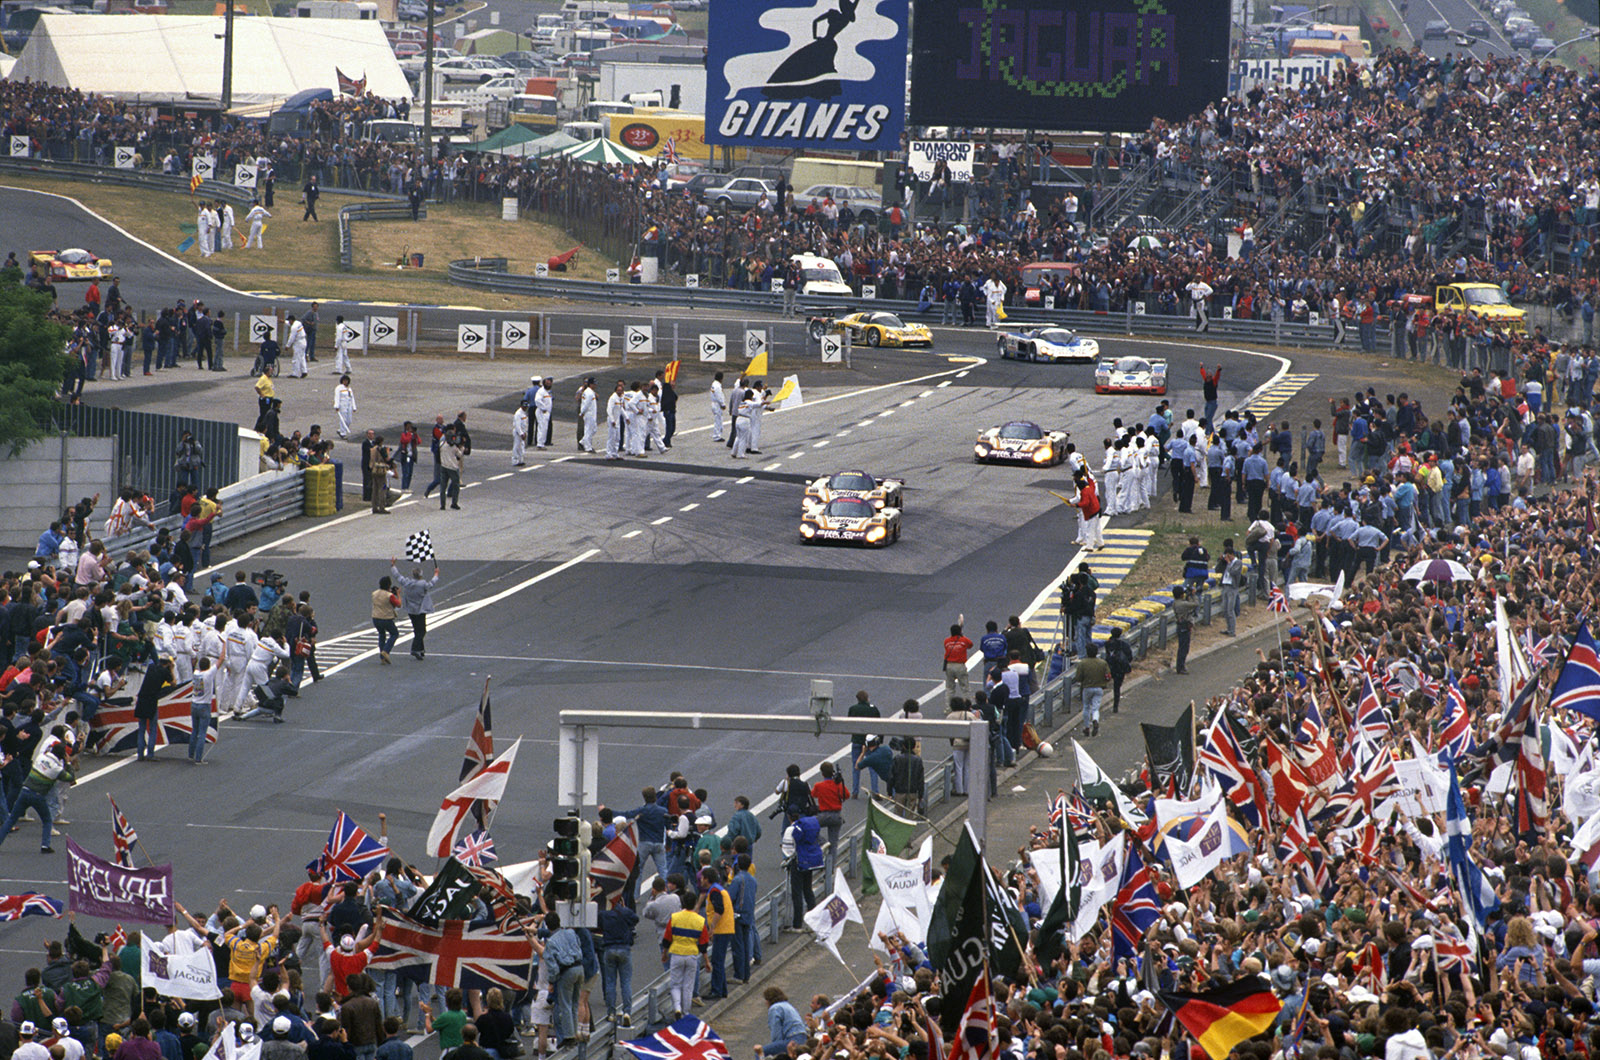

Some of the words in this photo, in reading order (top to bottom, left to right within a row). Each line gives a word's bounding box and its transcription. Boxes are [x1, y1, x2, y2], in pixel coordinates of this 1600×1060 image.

[956, 8, 1179, 86] JAGUAR
[718, 99, 890, 141] GITANES
[913, 142, 971, 153] DIAMOND
[926, 151, 967, 162] VISION
[67, 847, 168, 911] JAGUAR
[174, 969, 212, 984] JAGUAR
